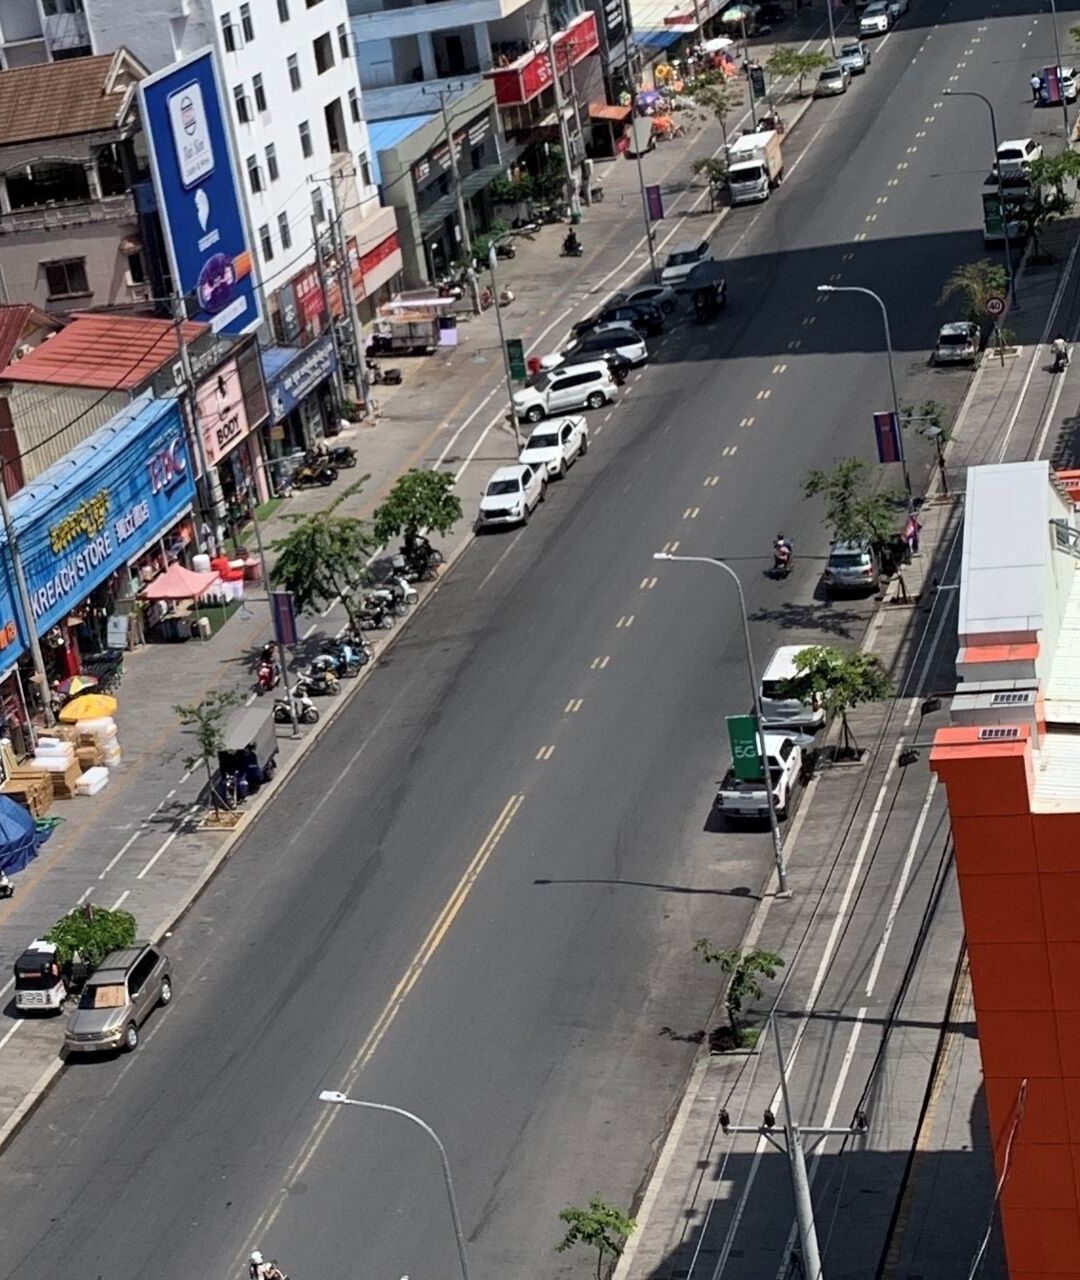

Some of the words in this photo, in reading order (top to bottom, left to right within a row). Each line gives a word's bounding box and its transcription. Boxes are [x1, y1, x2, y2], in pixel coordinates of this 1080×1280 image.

[216, 412, 239, 445] BODY
[30, 568, 79, 618] KREACH
[77, 531, 113, 582] STORE
[735, 745, 756, 758] 5G
